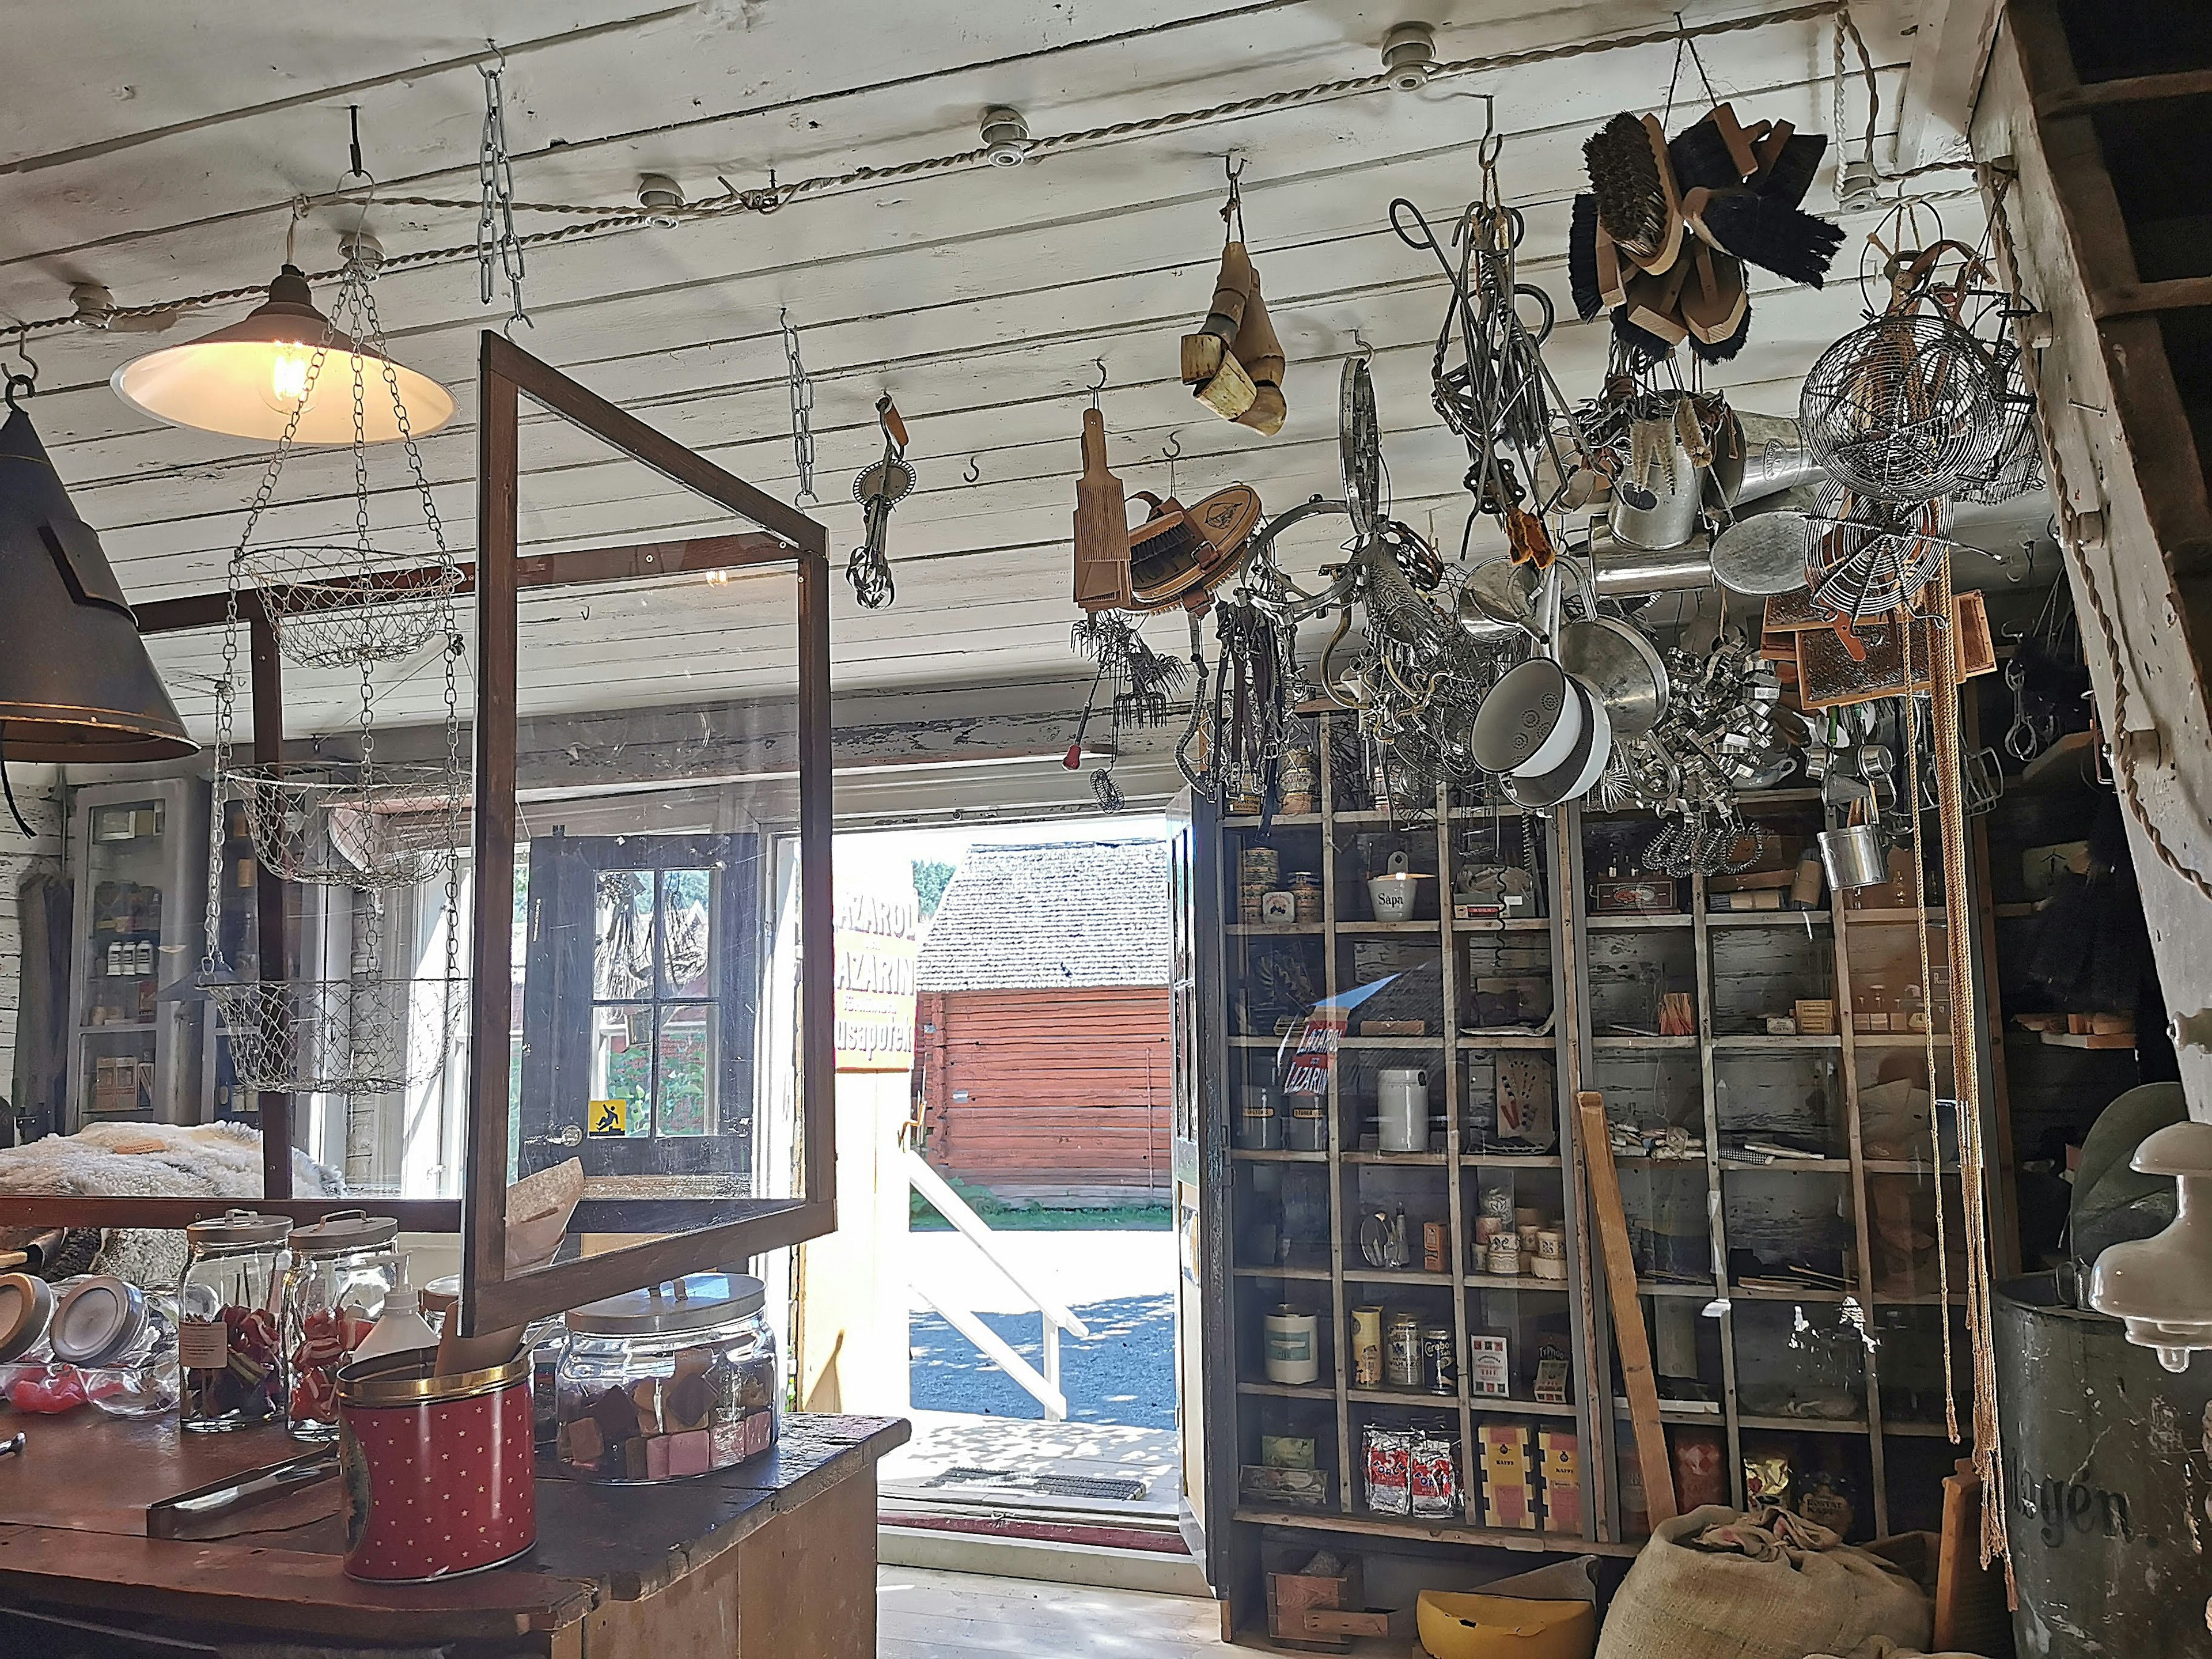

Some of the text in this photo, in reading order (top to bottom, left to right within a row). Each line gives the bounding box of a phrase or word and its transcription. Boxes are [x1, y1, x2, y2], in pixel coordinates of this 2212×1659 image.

[836, 894, 915, 941] AZAROL
[837, 951, 915, 996] AZARIN
[837, 1016, 912, 1061] usapotek
[1425, 1341, 1450, 1357] Cerebo
